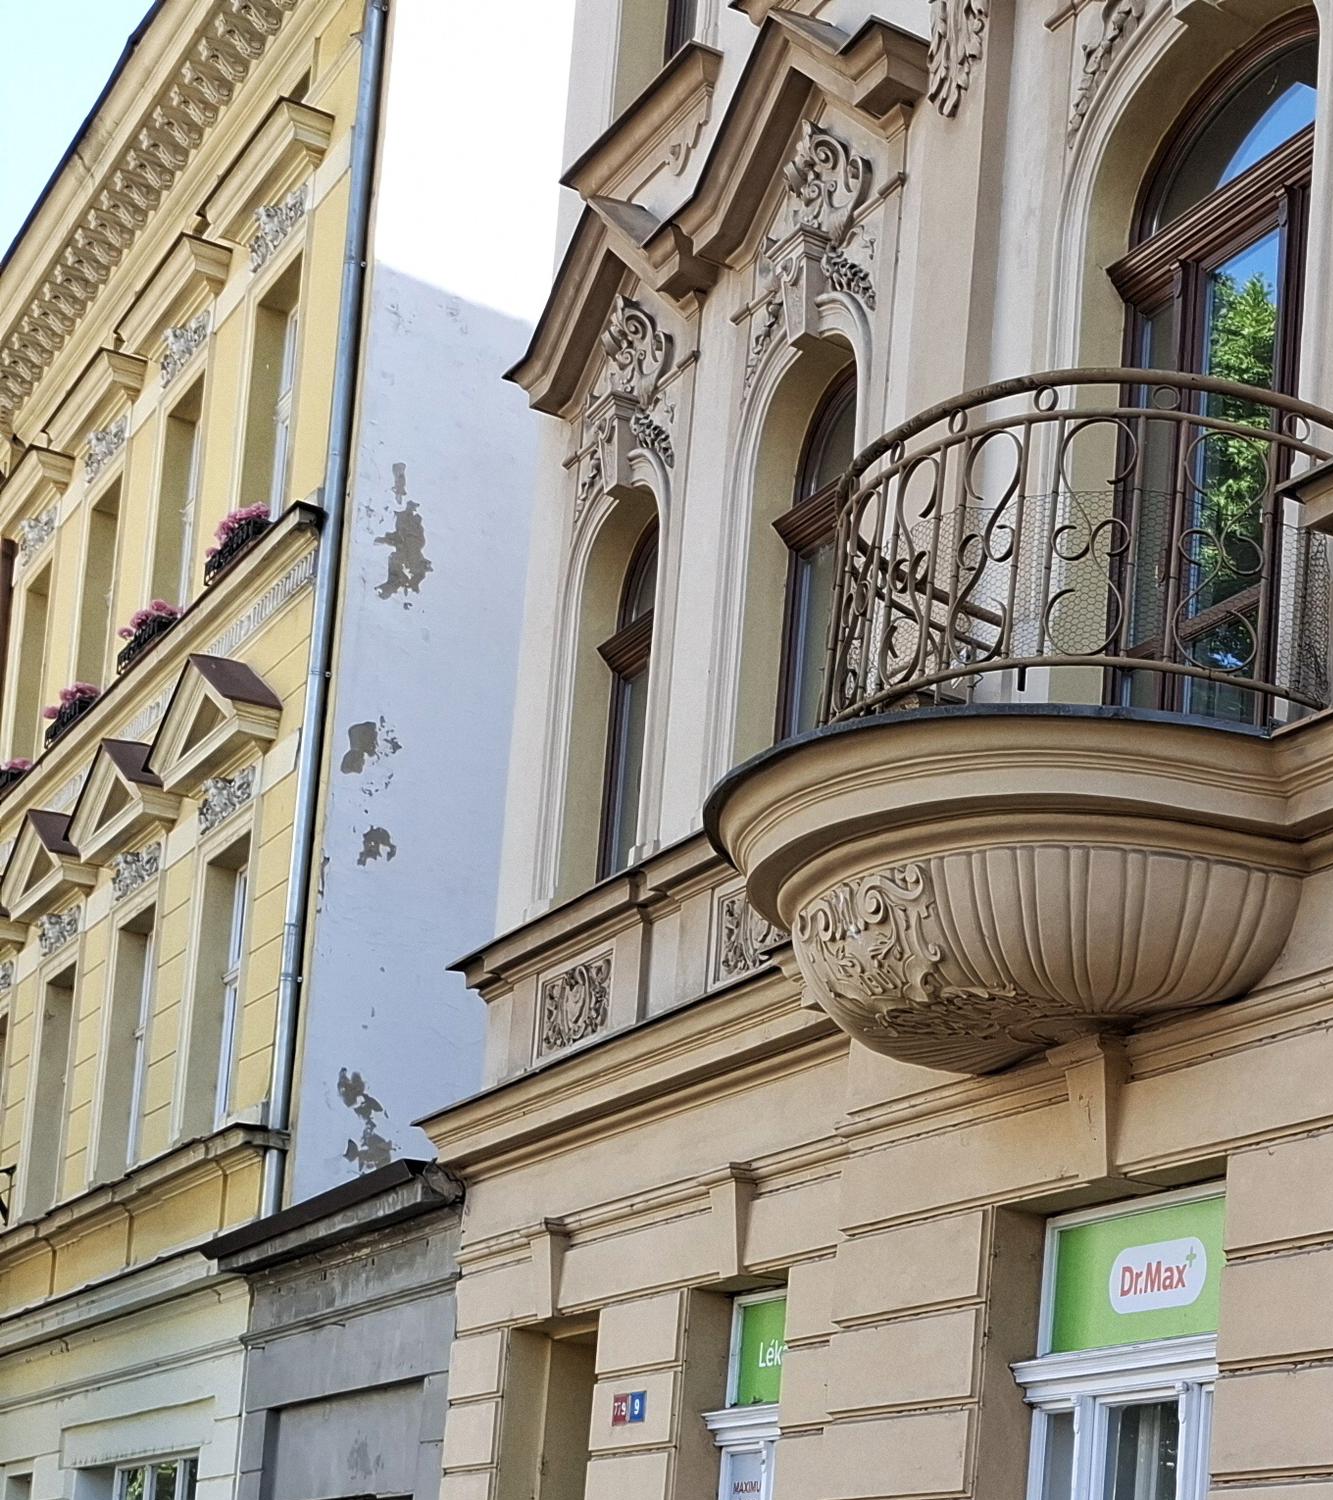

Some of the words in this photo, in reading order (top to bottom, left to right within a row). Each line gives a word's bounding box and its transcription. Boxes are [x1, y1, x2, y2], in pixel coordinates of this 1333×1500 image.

[1120, 1261, 1187, 1297] Dr.Max
[759, 1339, 787, 1367] Lék
[634, 1399, 640, 1415] 9
